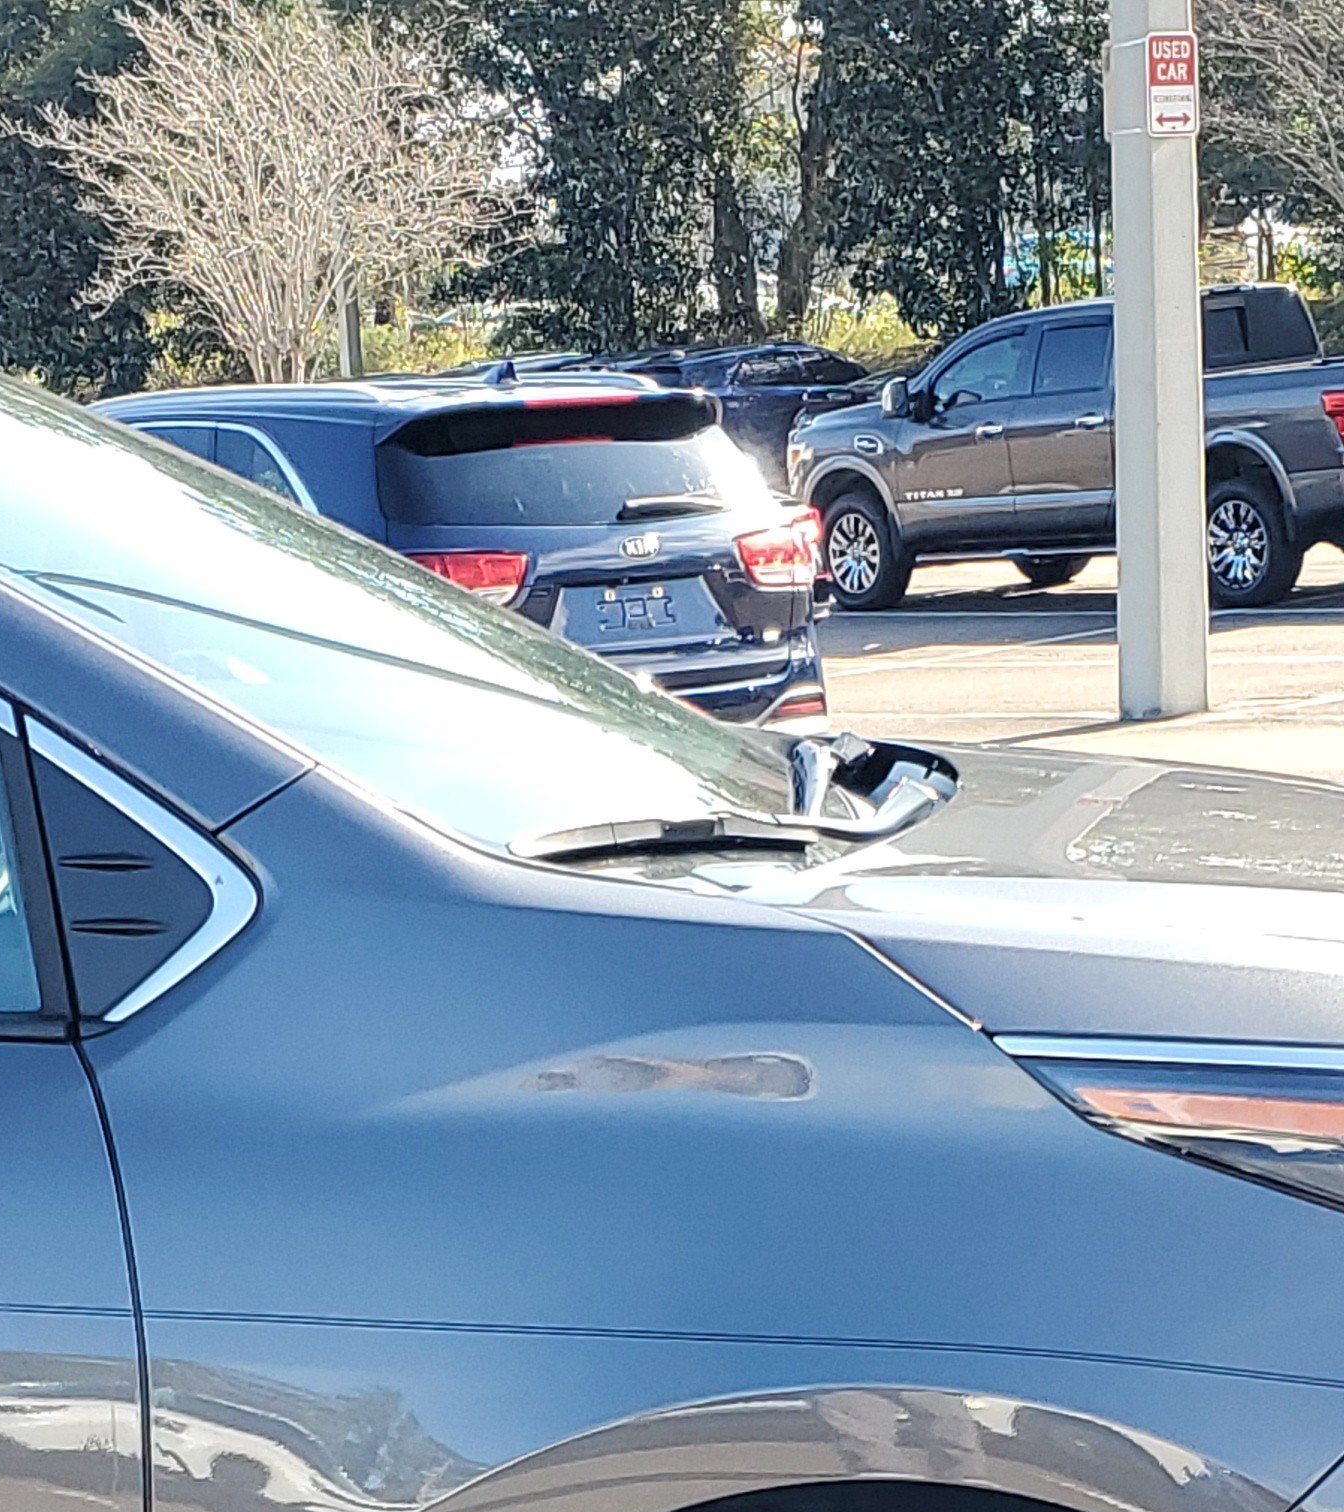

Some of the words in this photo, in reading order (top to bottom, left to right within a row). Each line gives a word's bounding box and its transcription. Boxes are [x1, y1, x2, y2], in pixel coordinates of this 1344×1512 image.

[1152, 41, 1191, 59] USED
[1156, 63, 1188, 80] CAR
[905, 489, 944, 501] TITAN
